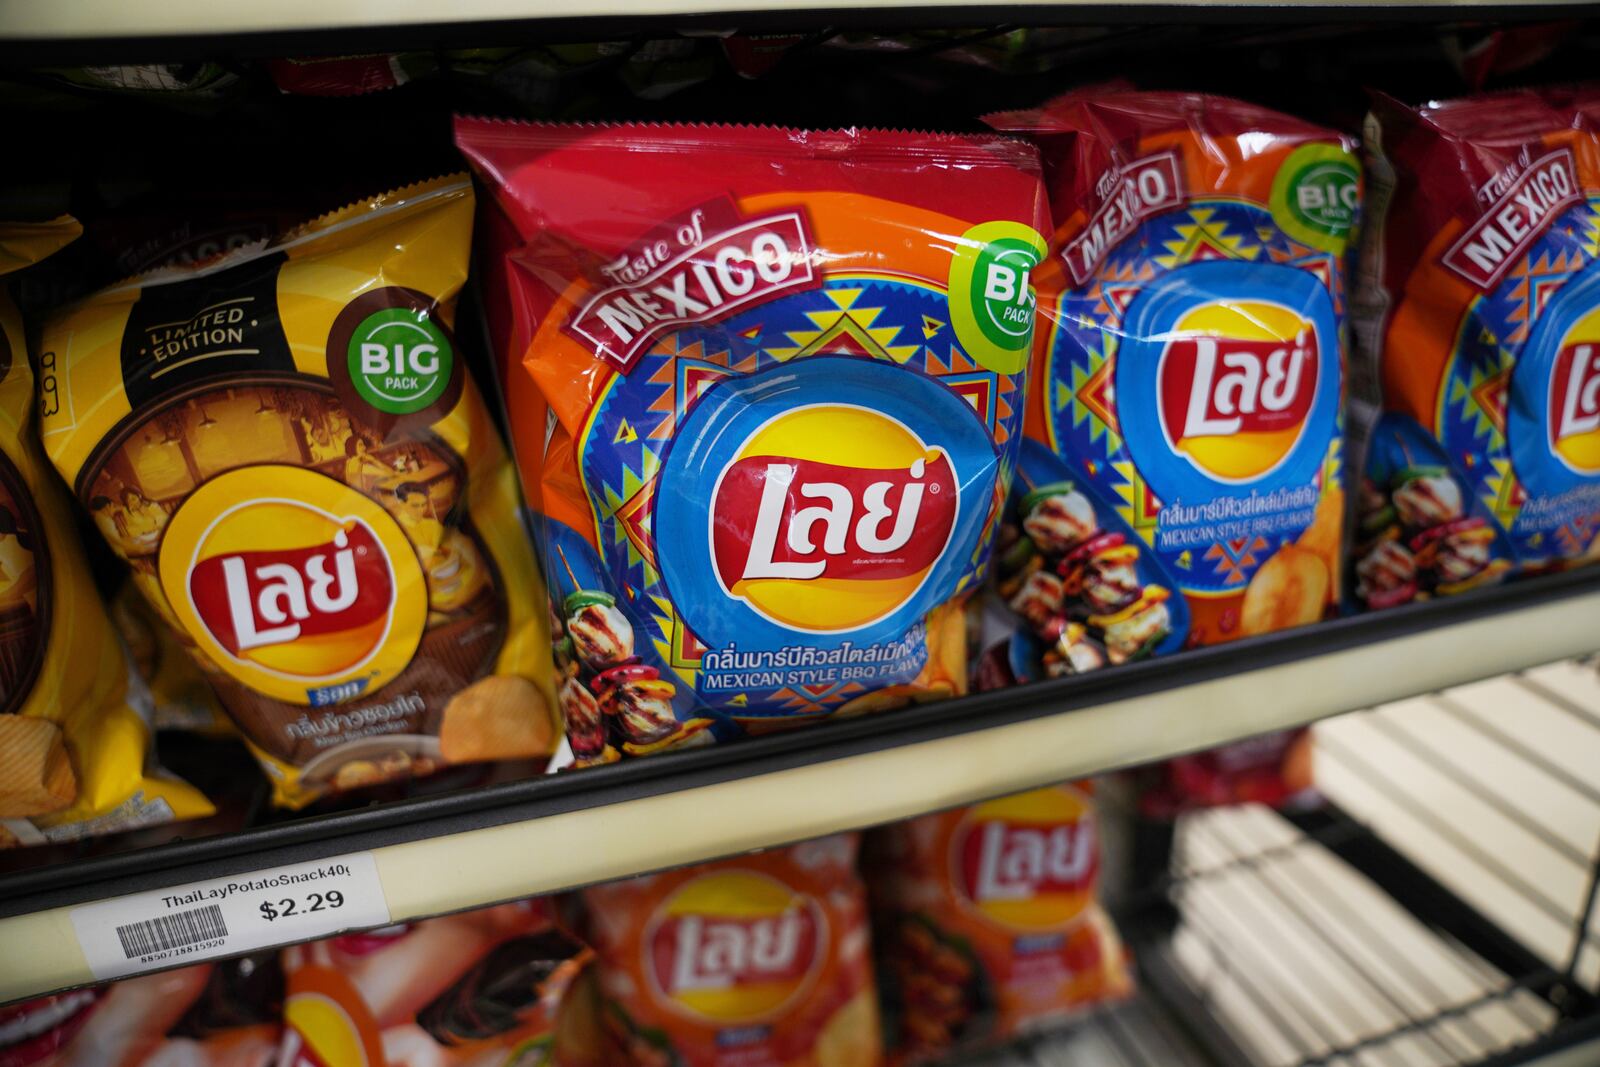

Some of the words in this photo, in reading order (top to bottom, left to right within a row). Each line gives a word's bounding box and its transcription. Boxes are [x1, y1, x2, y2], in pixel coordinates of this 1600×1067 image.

[1463, 162, 1569, 273] MEXICO
[601, 240, 671, 284] Taste
[676, 209, 705, 246] of
[596, 231, 802, 344] MEXICO
[984, 262, 1034, 307] BI
[152, 308, 244, 345] LIMITED
[153, 328, 243, 362] EDITION
[361, 343, 439, 375] BIG
[385, 377, 418, 390] PACK
[1161, 526, 1215, 546] MEXICAN
[706, 671, 784, 689] MEXICAN
[787, 667, 836, 685] STYLE
[841, 665, 876, 680] BBQ
[259, 889, 344, 922] $2.29
[141, 938, 225, 964] 8850718815920
